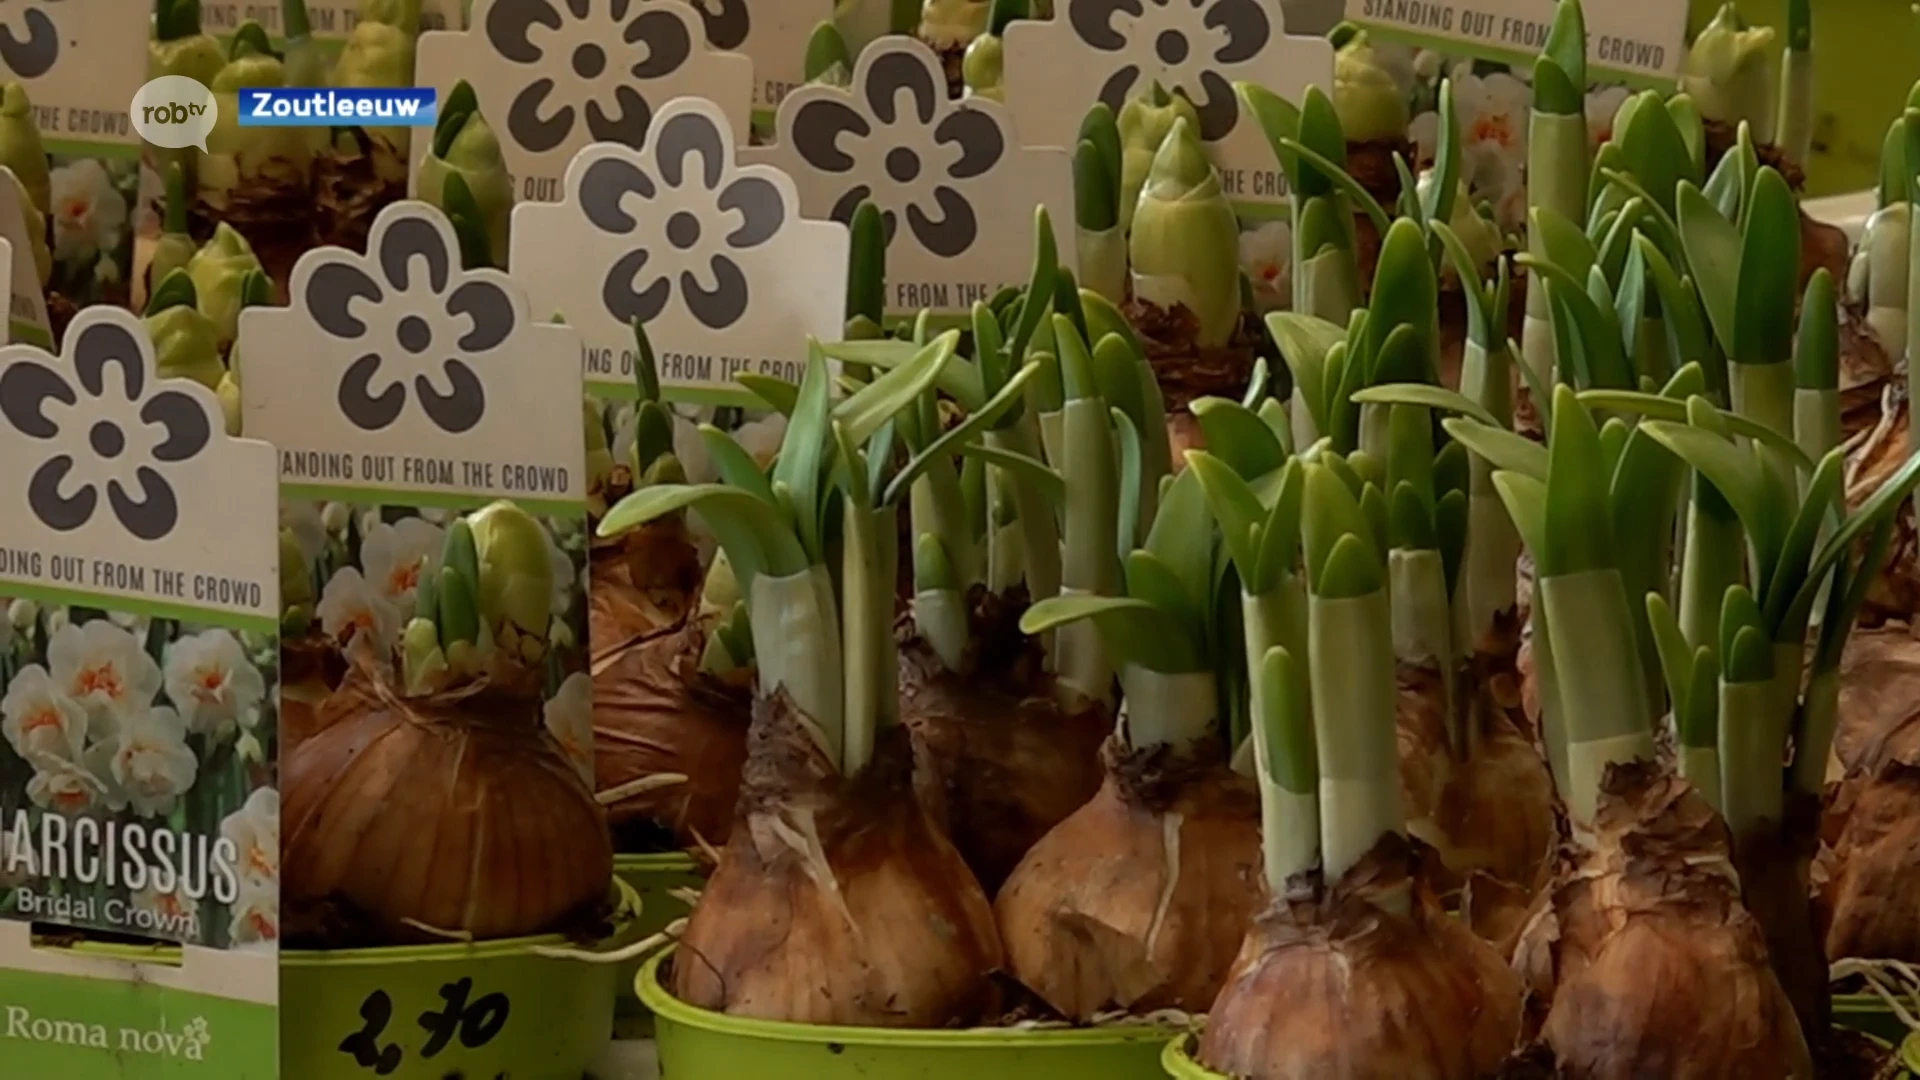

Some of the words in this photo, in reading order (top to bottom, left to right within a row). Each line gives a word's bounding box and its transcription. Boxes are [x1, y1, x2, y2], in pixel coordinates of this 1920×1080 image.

[1460, 10, 1495, 38] OUT
[1598, 35, 1665, 70] CROWD
[67, 108, 129, 137] CROWD
[524, 176, 559, 202] OUT
[1253, 170, 1288, 197] CRO
[897, 283, 949, 308] FROM
[661, 353, 711, 381] FROM
[758, 358, 806, 386] CROW
[361, 455, 395, 482] OUT
[403, 457, 454, 485] FROM
[461, 461, 494, 488] THE
[502, 464, 568, 493] CROWD
[50, 555, 85, 583] OUT
[93, 560, 145, 592] FROM
[152, 568, 185, 597] THE
[194, 574, 262, 608] CROWD
[0, 808, 238, 904] ARCISSUS
[17, 887, 96, 920] Bridal
[104, 899, 198, 935] Crown
[5, 1005, 109, 1048] Roma
[119, 1026, 203, 1061] nova
